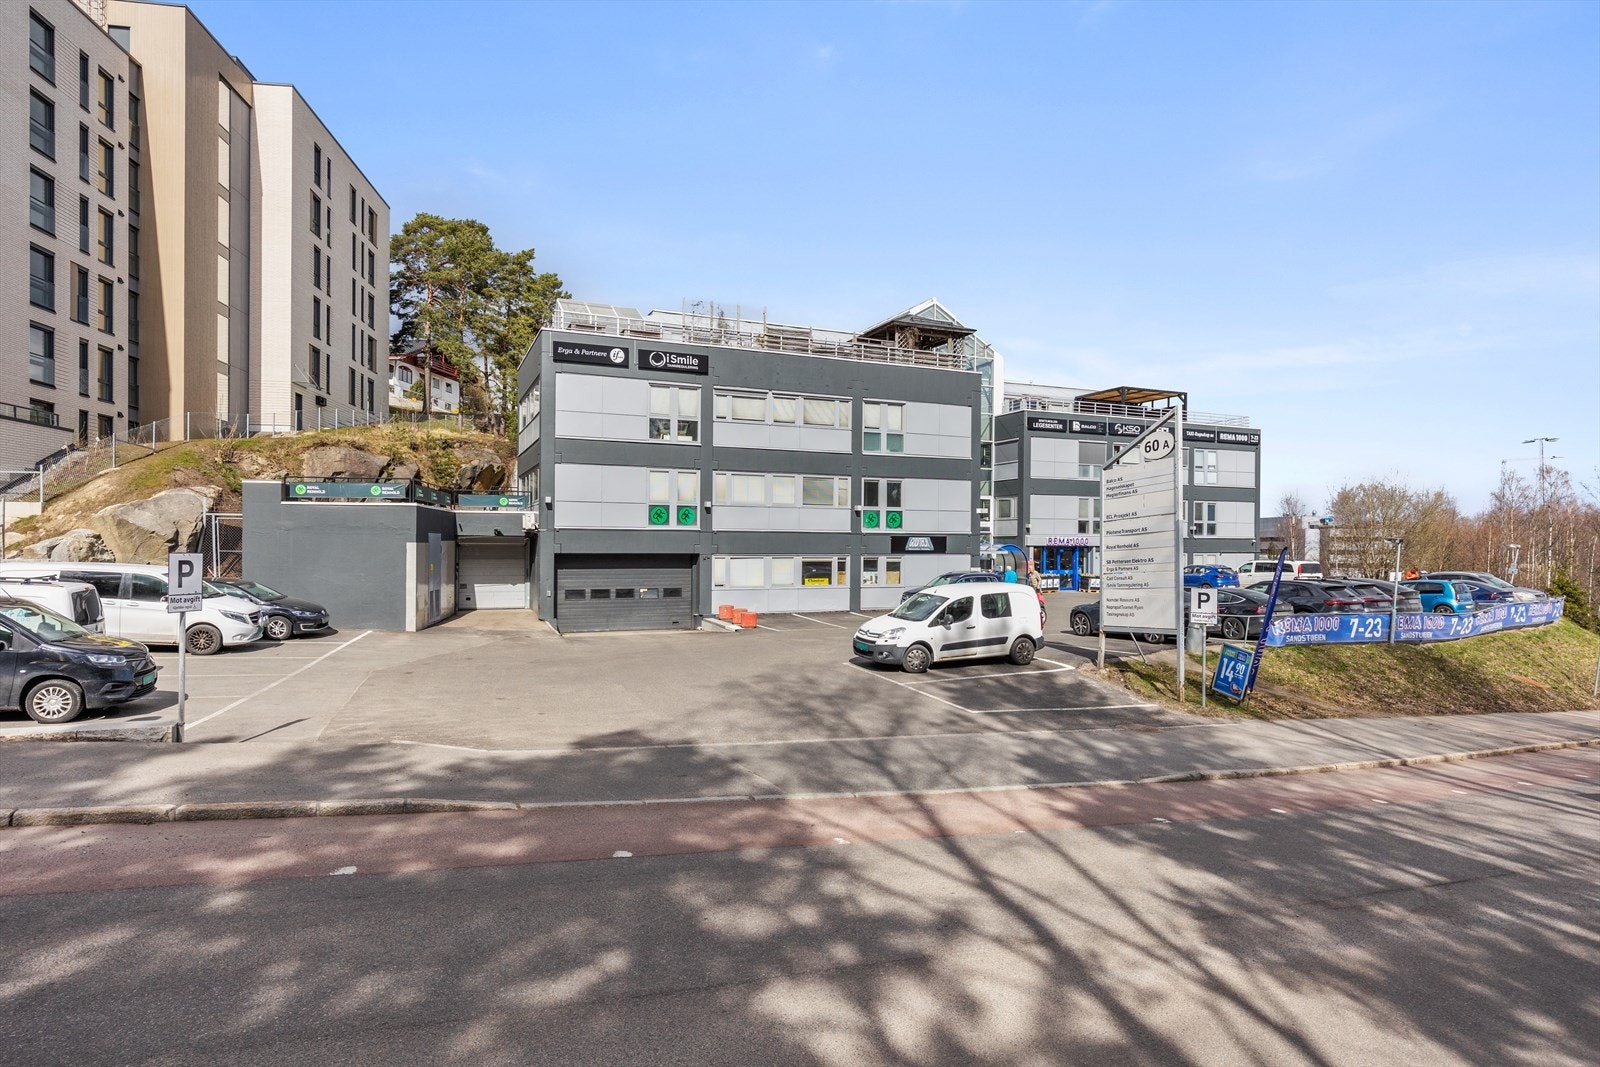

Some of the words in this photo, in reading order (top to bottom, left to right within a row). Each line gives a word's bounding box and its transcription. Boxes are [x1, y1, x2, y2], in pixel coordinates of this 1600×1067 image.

[558, 346, 572, 355] Erga
[581, 349, 608, 357] Partnere
[1220, 432, 1236, 440] REMA
[1144, 440, 1160, 453] 60
[1162, 440, 1170, 450] A
[1048, 537, 1070, 545] REMA
[1072, 537, 1089, 545] 1000
[178, 560, 194, 588] P
[183, 596, 200, 604] avgift
[1198, 592, 1210, 609] P
[1314, 616, 1340, 632] 1000
[1350, 618, 1382, 638] 7-23
[1395, 615, 1422, 630] EMA
[1423, 615, 1445, 630] 1000
[1450, 617, 1474, 636] 7-23
[1220, 658, 1234, 682] 14
[1236, 663, 1245, 674] 90
